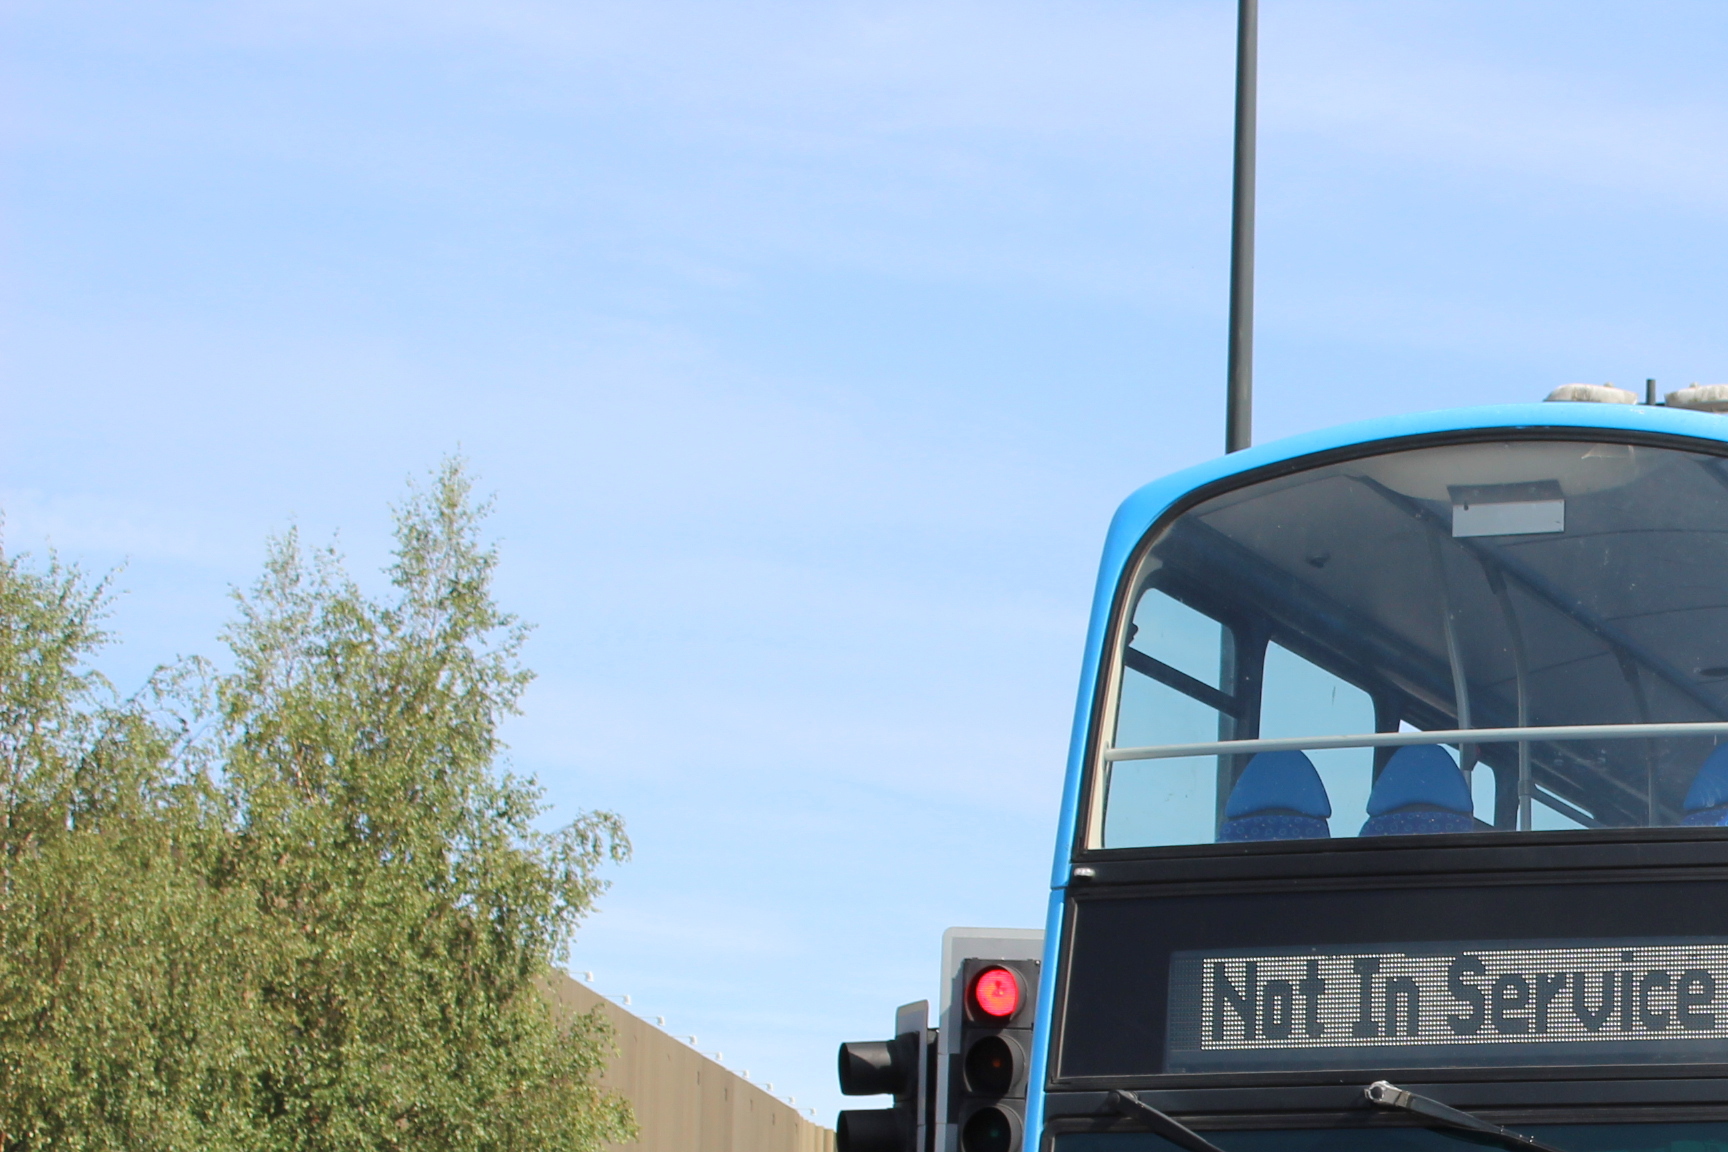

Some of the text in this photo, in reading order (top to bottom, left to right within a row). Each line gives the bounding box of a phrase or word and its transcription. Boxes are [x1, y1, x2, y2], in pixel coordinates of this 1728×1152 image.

[1212, 949, 1718, 1043] Not In Service
